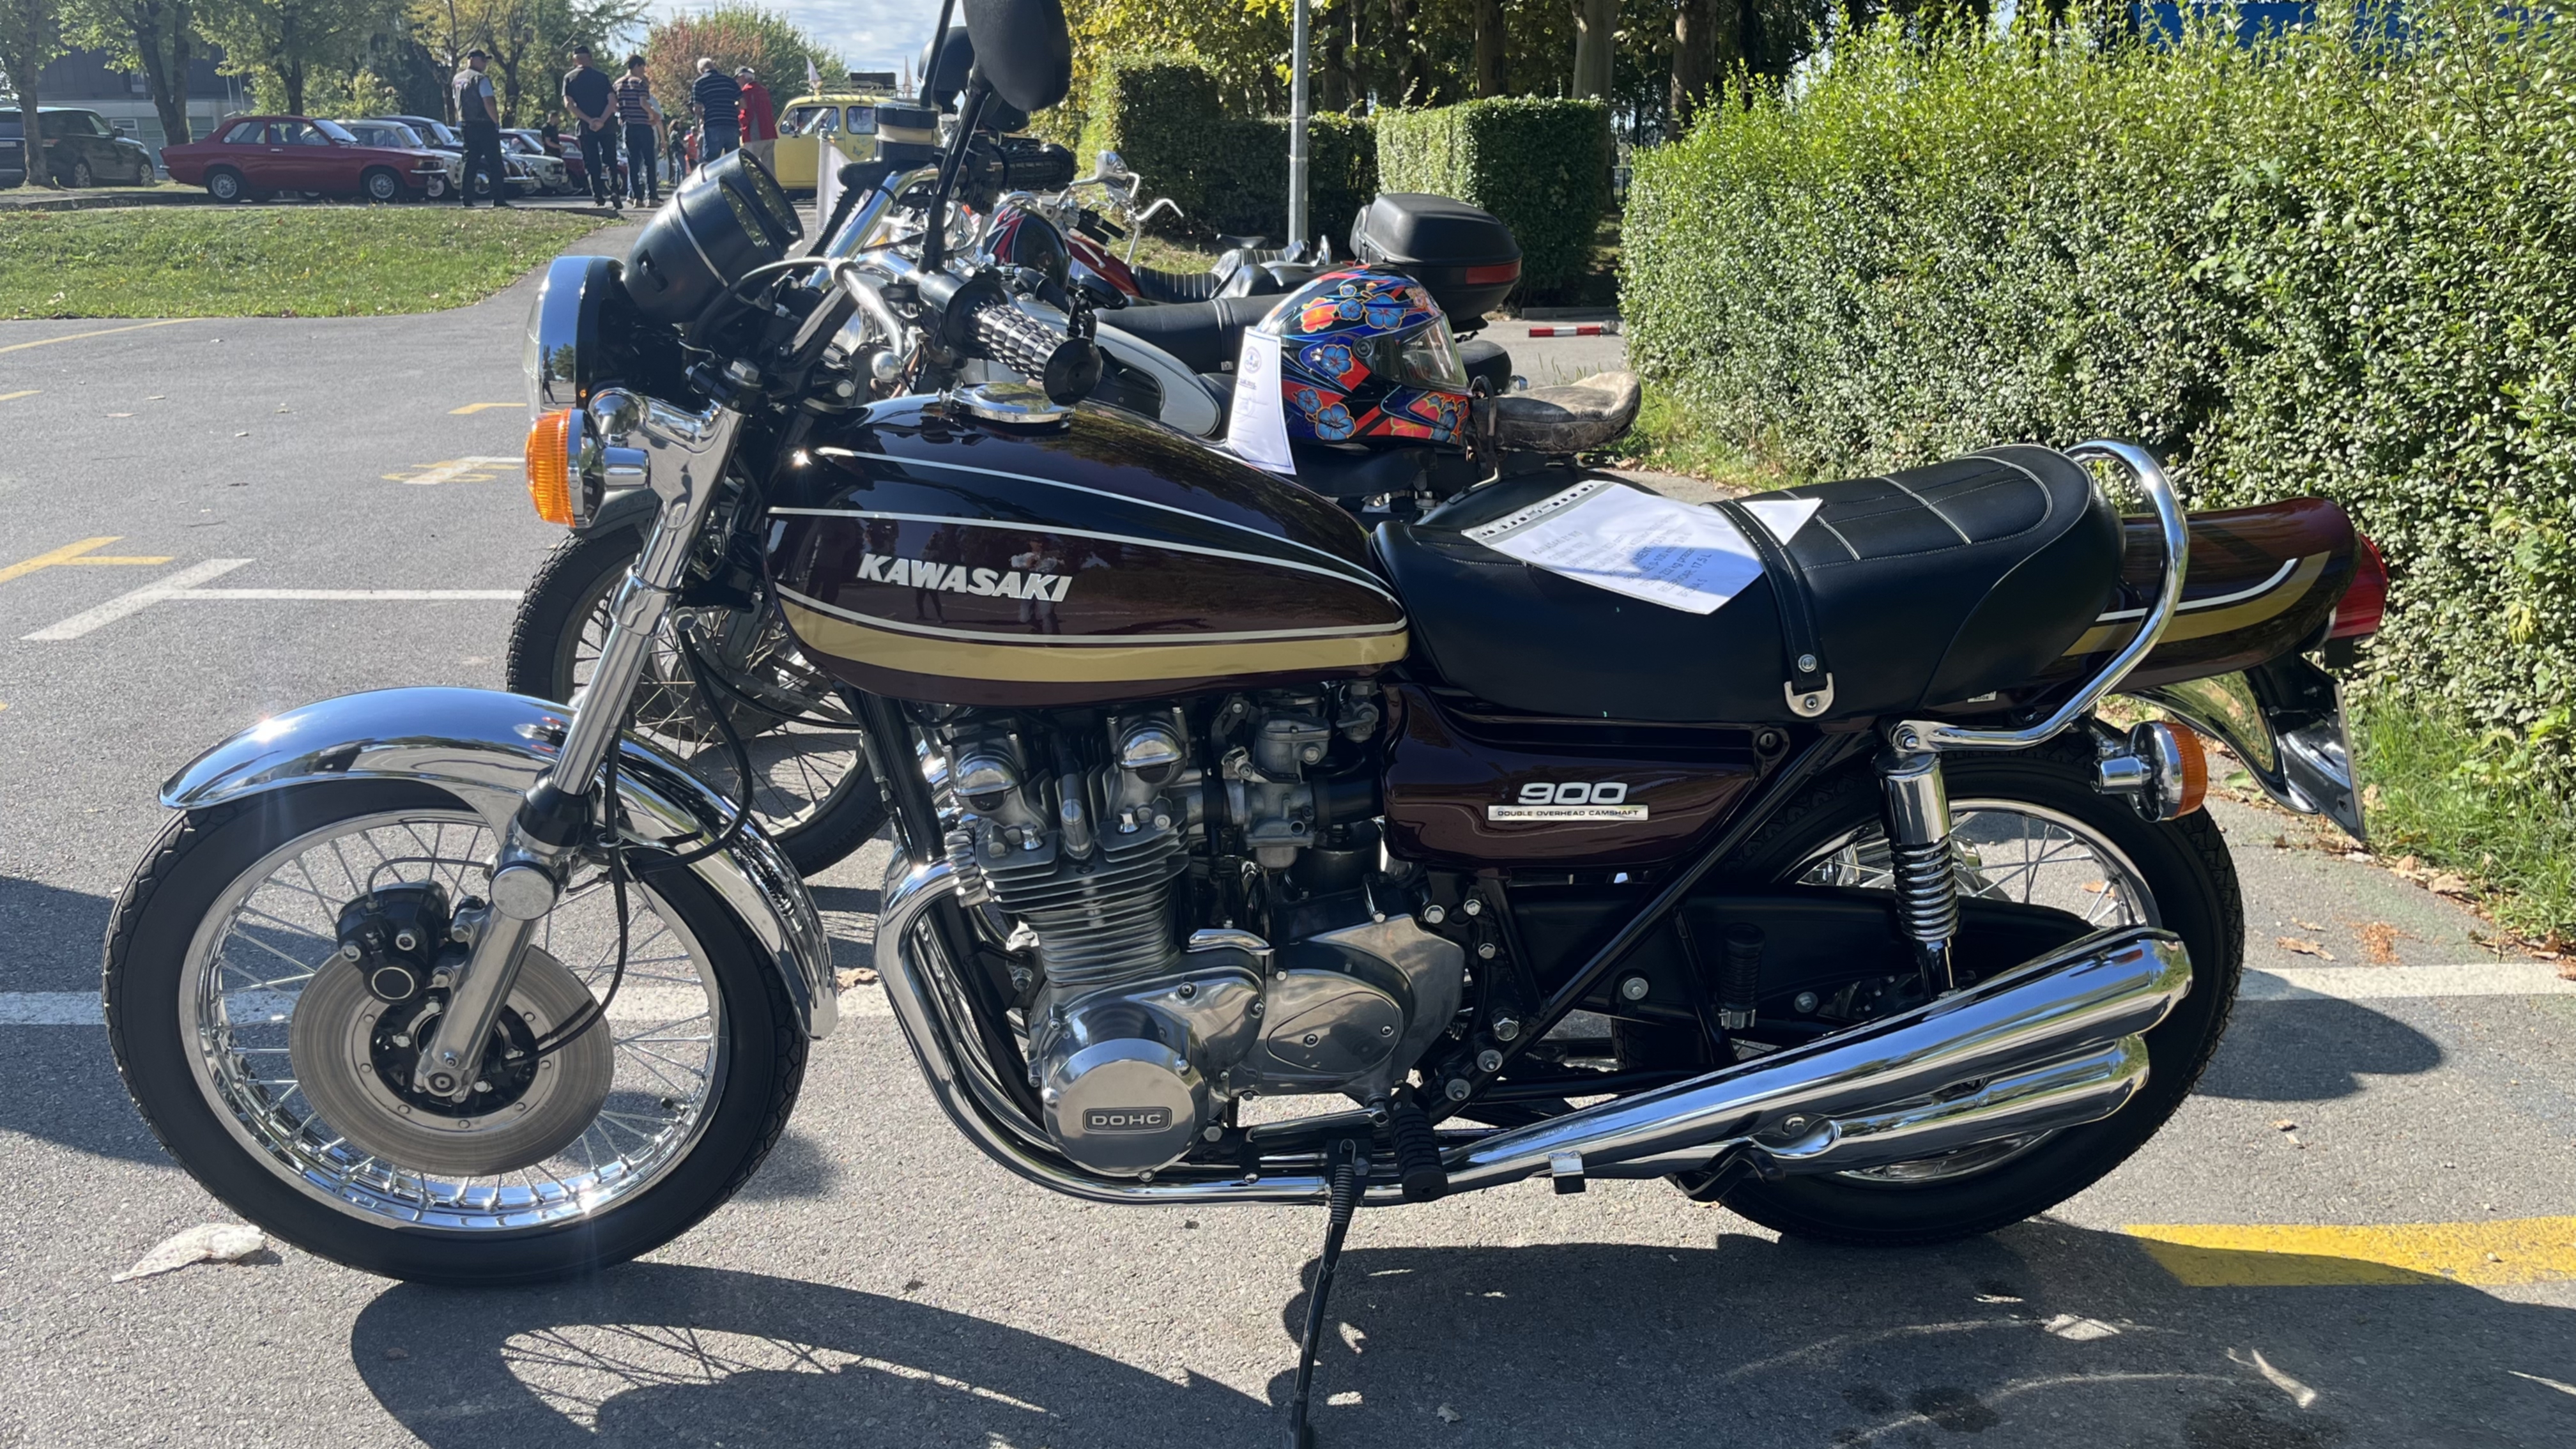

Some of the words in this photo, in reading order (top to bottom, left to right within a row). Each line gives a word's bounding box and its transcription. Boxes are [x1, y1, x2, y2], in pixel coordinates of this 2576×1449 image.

[857, 553, 1073, 602] KAWASAKI
[1517, 782, 1629, 805] 900
[1091, 1114, 1162, 1126] DOHC
